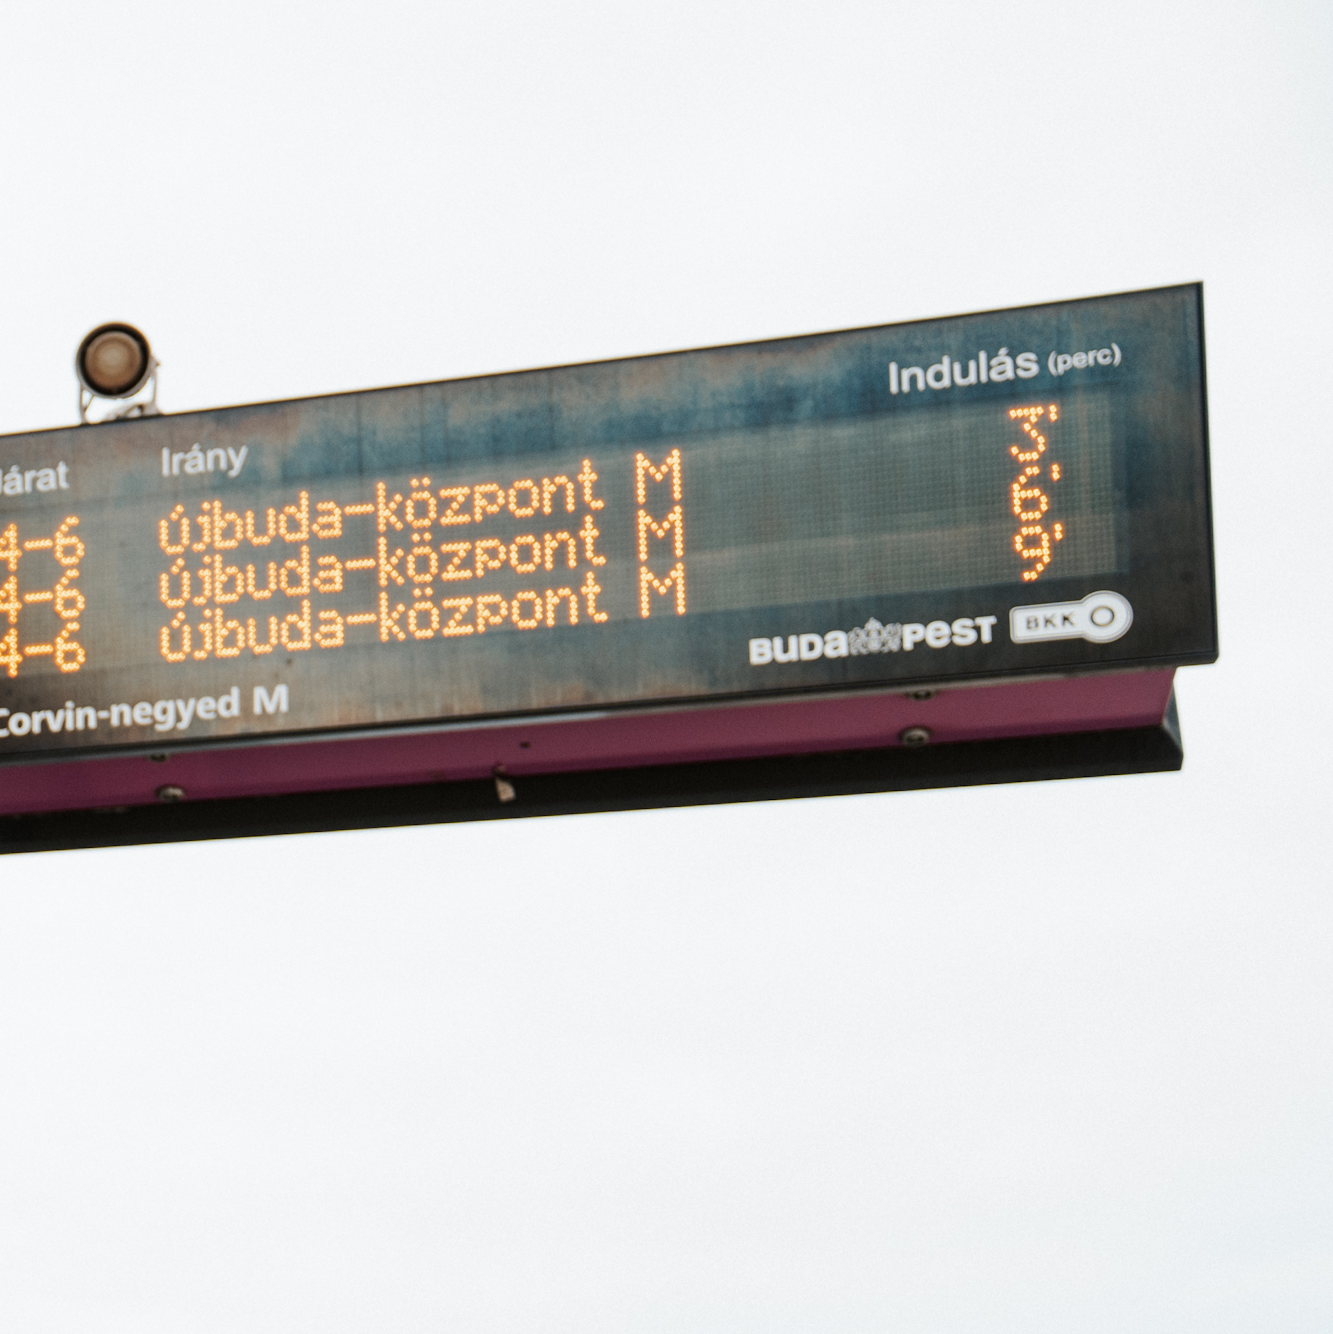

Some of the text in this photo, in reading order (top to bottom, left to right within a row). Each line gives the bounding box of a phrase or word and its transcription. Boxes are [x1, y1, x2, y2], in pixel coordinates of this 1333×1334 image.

[889, 343, 1122, 395] Indulás (perc)
[161, 443, 249, 478] Irány
[635, 448, 683, 505] M
[637, 504, 685, 562] M
[639, 561, 687, 620] M
[1025, 611, 1077, 631] BKK
[252, 684, 290, 716] M
